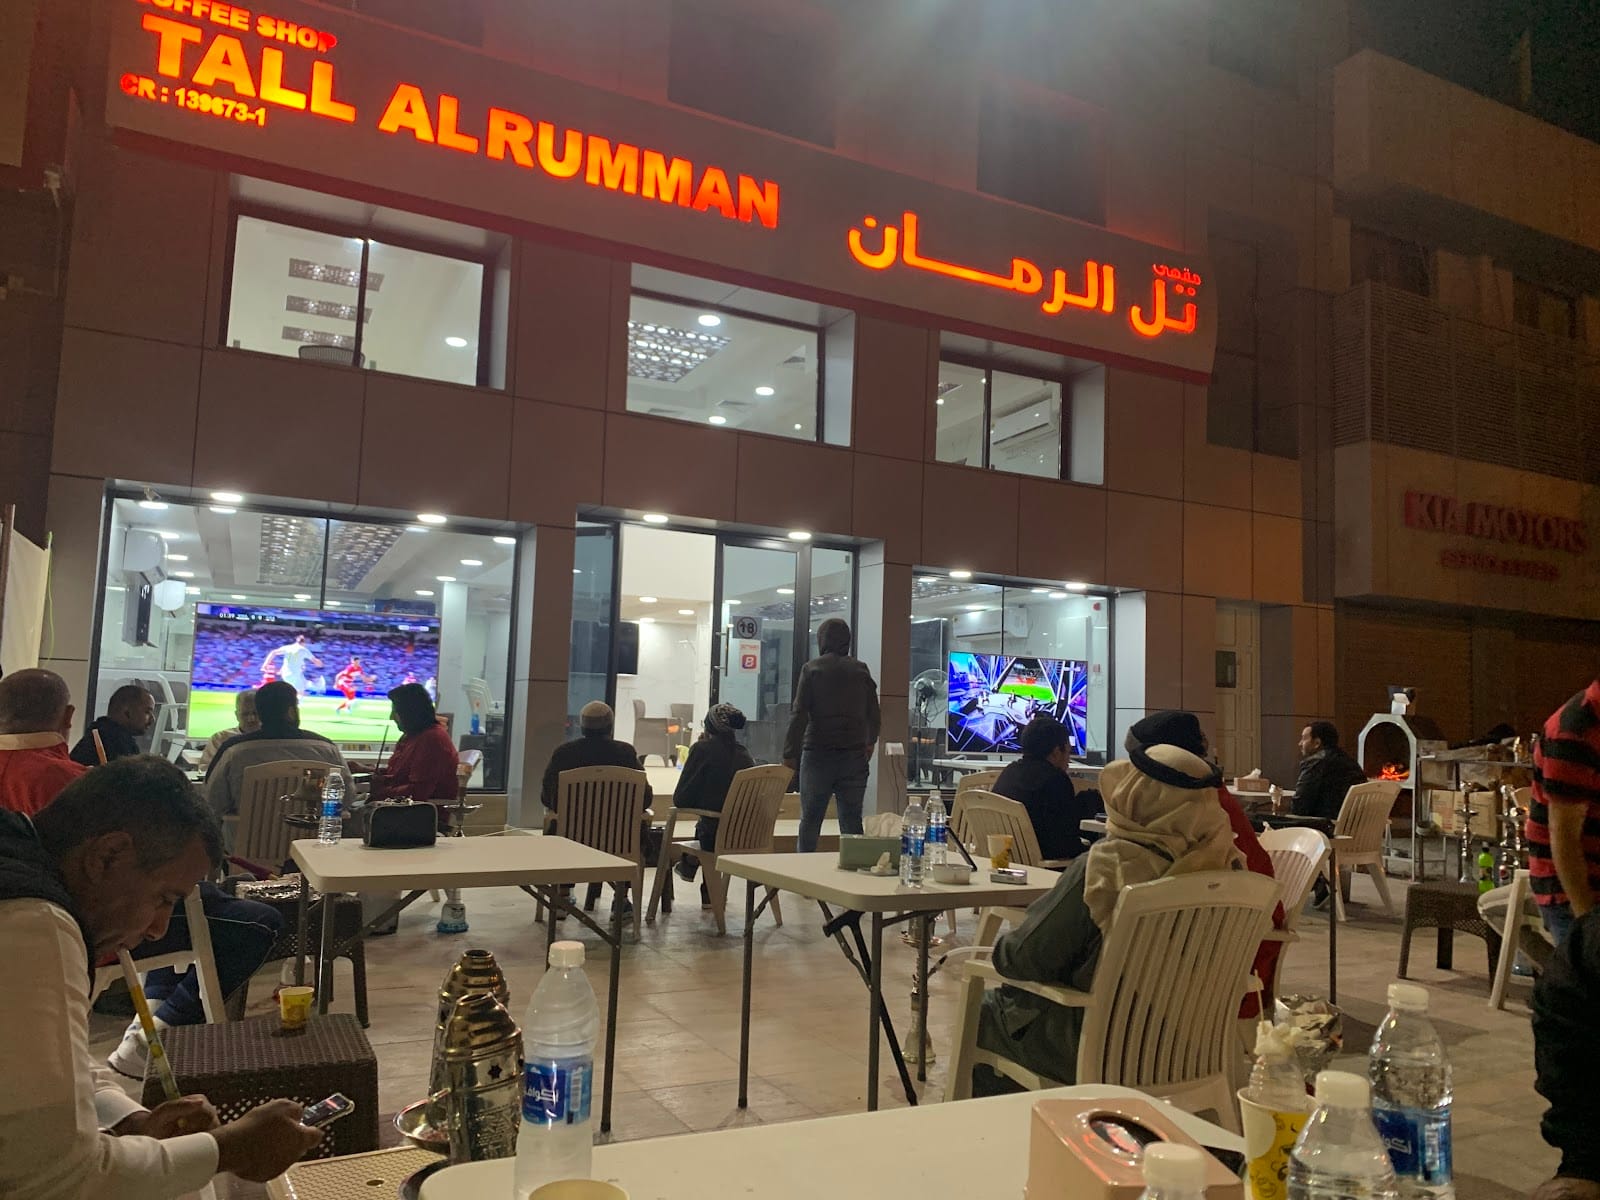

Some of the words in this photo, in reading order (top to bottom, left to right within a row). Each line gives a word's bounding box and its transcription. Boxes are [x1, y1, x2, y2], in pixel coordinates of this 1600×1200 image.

[255, 15, 338, 53] SHOP
[142, 13, 356, 123] TALL
[1128, 278, 1197, 339] تل
[1404, 491, 1465, 535] KIA
